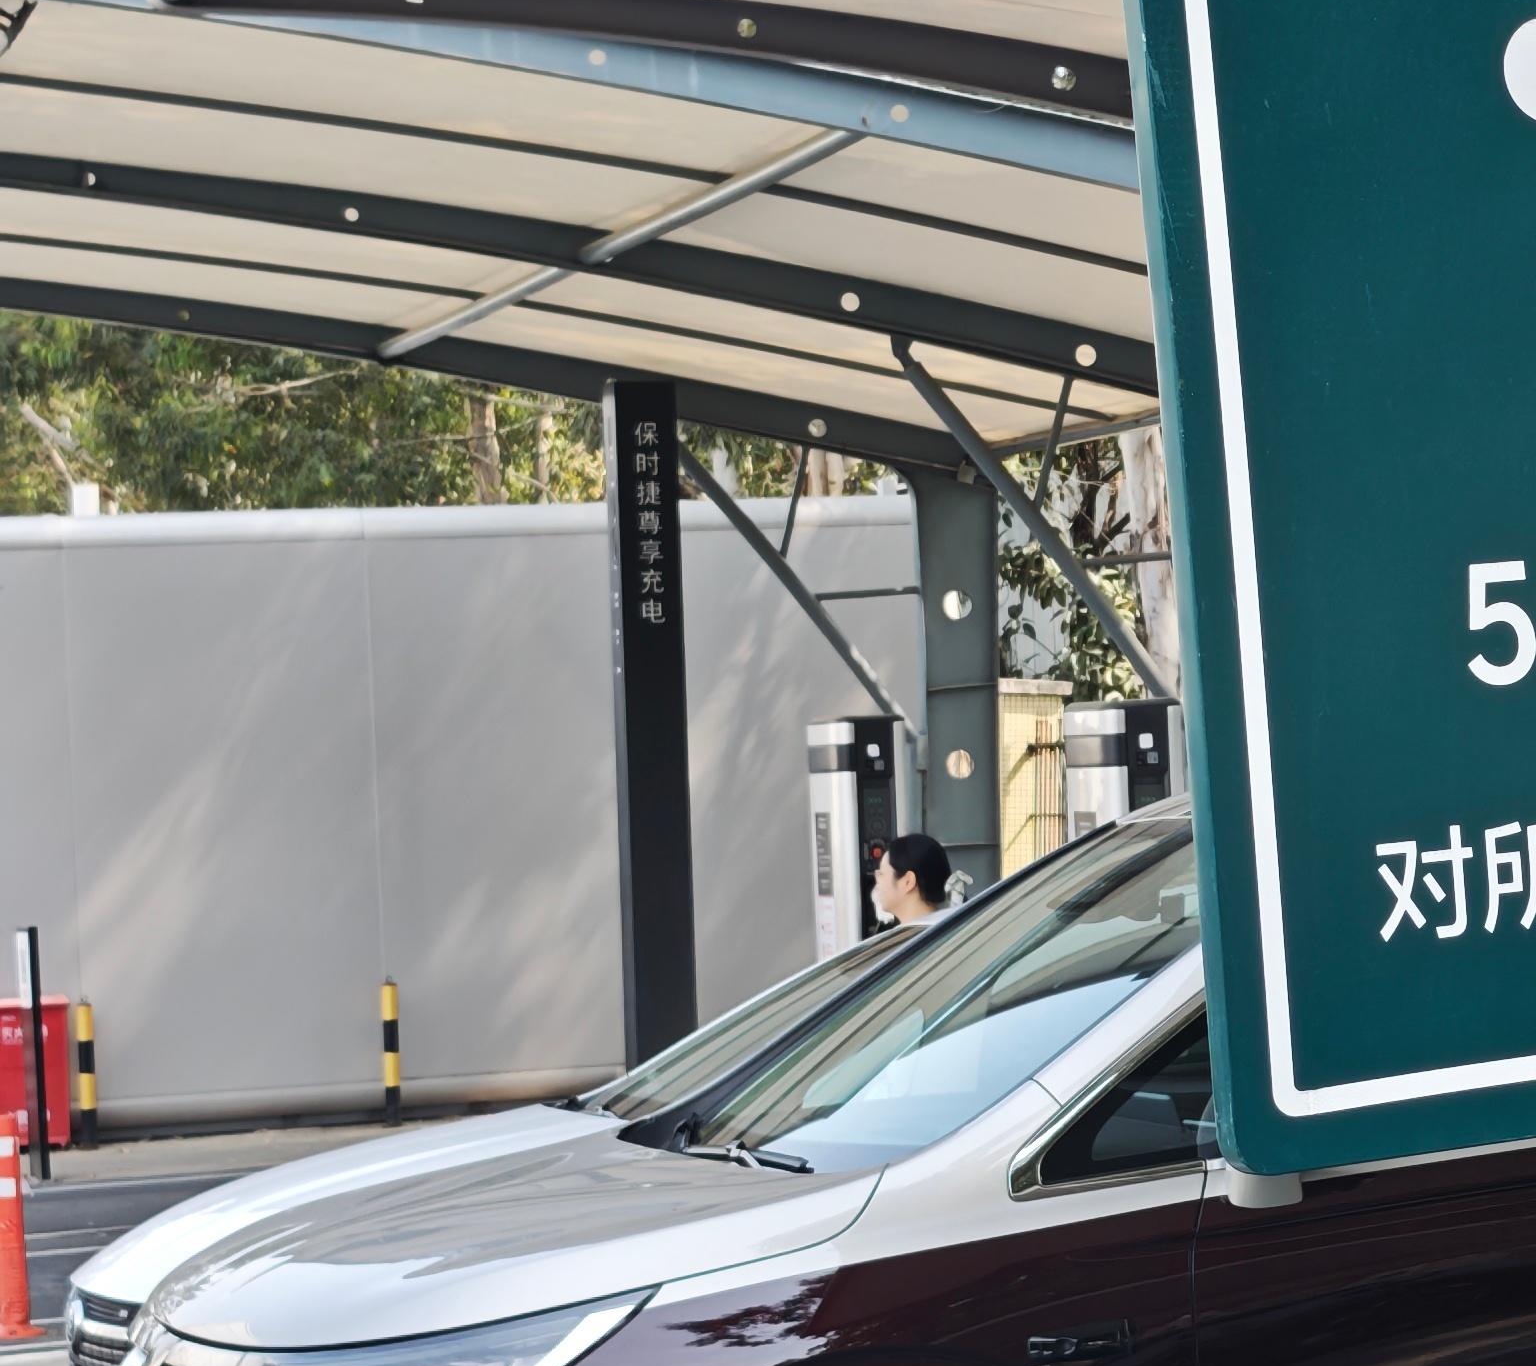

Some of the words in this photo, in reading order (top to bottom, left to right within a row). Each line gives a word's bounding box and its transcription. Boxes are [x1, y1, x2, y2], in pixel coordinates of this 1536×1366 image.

[634, 421, 666, 624] 保时捷尊享充电
